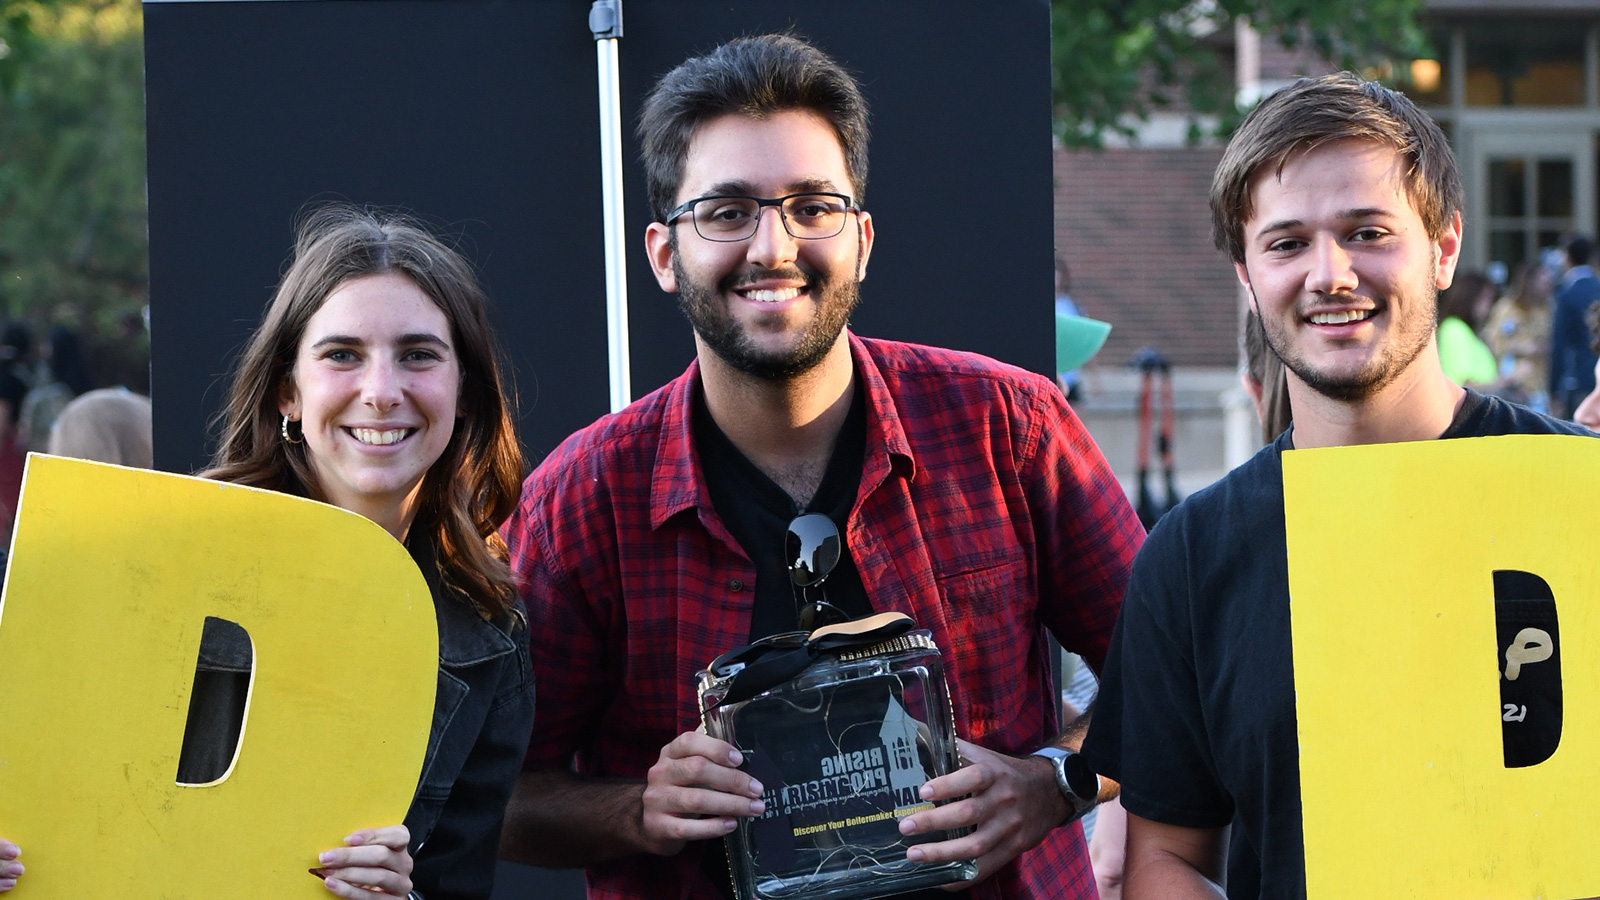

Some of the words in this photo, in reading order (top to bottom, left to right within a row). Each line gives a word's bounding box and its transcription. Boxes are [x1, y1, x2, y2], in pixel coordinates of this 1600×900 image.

[793, 822, 827, 837] Discover
[827, 818, 846, 832] Your
[846, 811, 893, 828] Boilermaker
